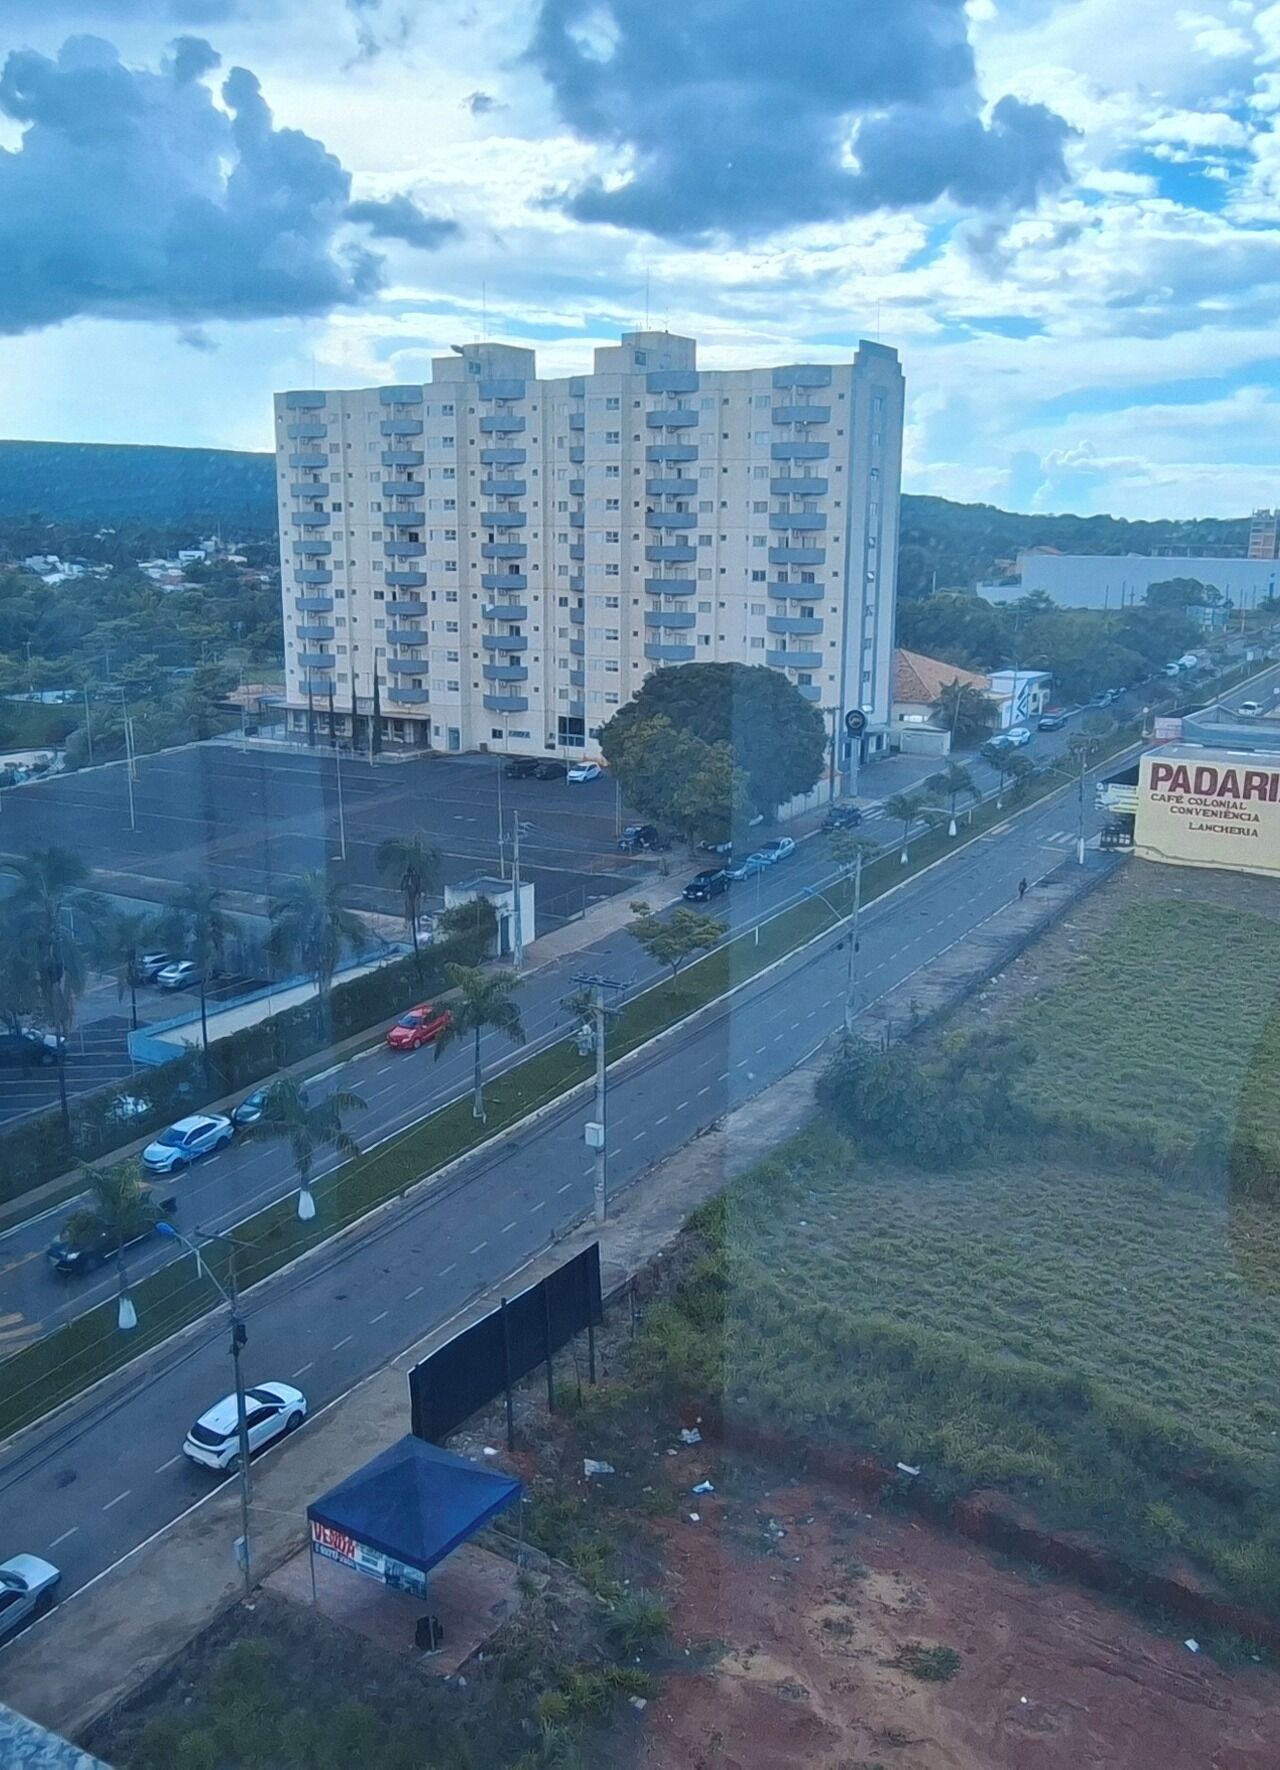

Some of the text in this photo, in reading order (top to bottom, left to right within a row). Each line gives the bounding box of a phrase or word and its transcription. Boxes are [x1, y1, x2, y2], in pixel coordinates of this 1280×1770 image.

[1150, 793, 1184, 805] CAFÉ
[1188, 797, 1247, 811] COLONIAL
[1189, 822, 1259, 838] LANCHERIA
